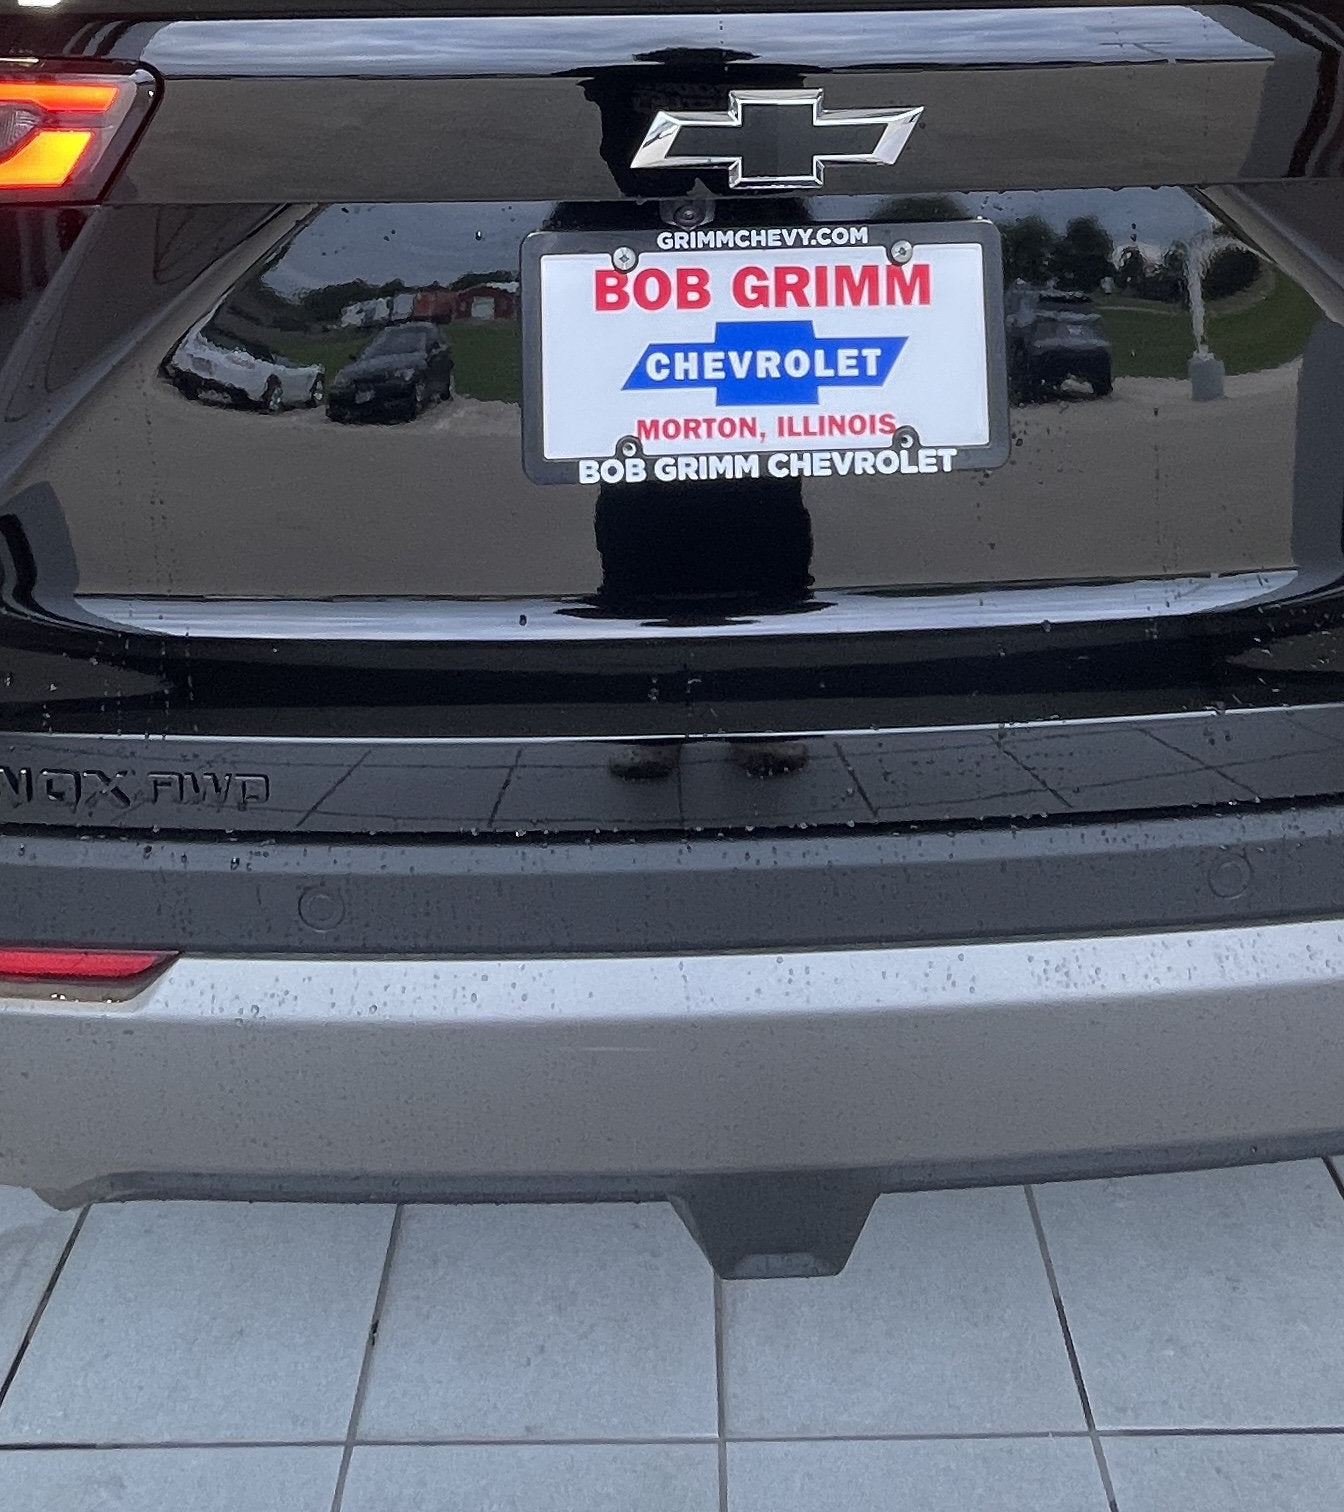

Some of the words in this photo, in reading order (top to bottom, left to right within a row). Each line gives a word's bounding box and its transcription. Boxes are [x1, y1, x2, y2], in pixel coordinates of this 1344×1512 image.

[656, 226, 869, 250] GRIMMCHEVY.COM
[594, 267, 712, 312] BOB
[732, 263, 931, 310] GRIMM
[645, 347, 883, 382] CHEVROLET
[636, 416, 767, 444] MORTON,
[776, 412, 897, 438] ILLINOIS
[577, 457, 647, 485] BOB
[653, 453, 760, 483] GRIMM
[767, 447, 959, 479] CHEVROLET
[147, 770, 272, 806] AWD
